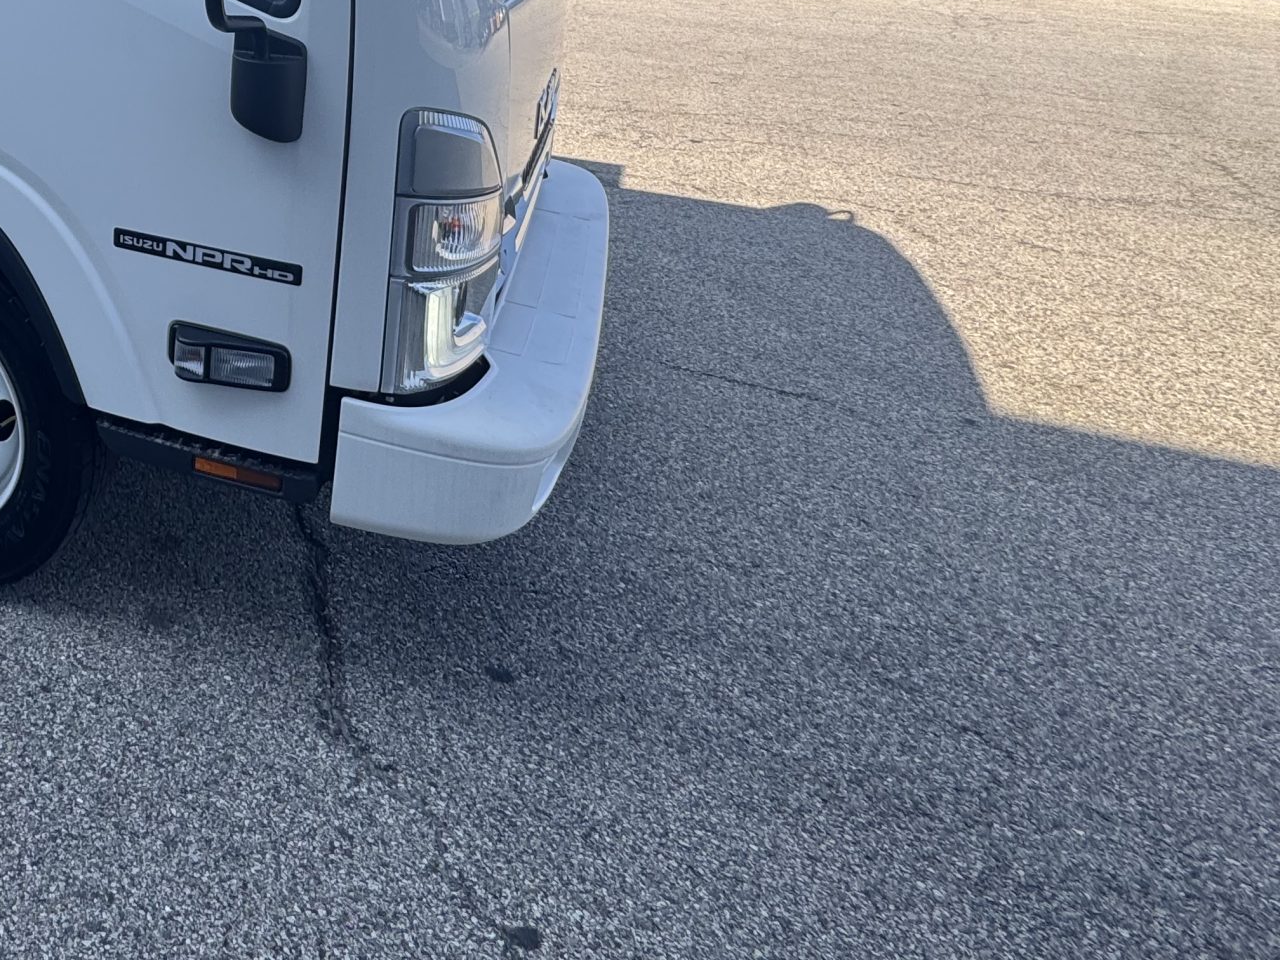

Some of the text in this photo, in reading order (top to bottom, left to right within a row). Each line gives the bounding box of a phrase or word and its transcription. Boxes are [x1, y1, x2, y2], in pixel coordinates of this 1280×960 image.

[120, 234, 294, 282] ISUZU NPR HD
